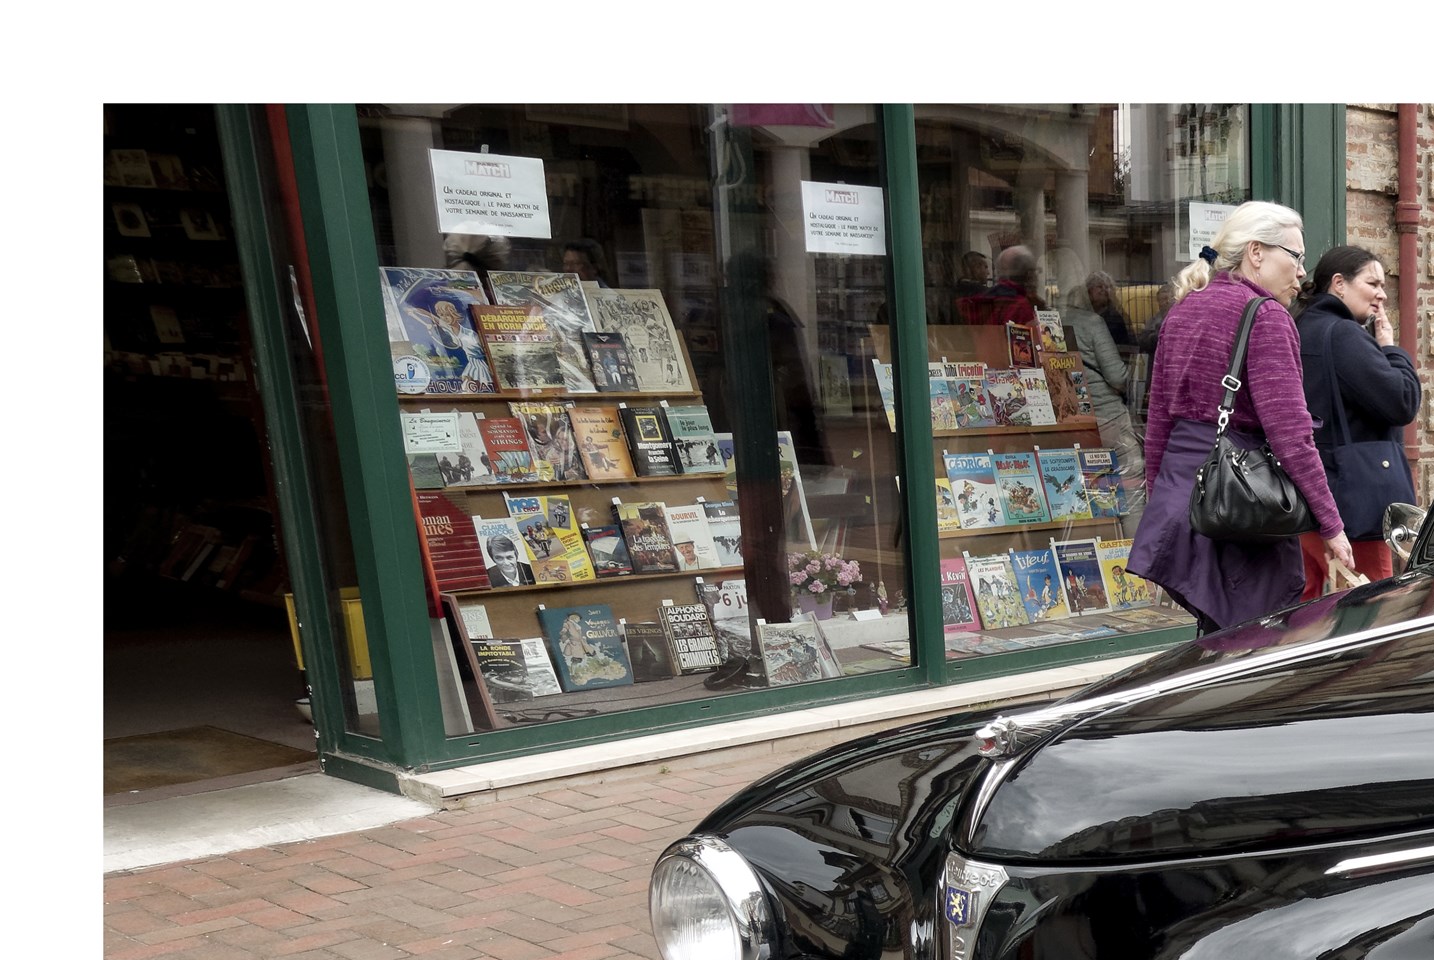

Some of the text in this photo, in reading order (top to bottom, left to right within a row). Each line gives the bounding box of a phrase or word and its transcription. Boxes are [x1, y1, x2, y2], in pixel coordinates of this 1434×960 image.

[465, 161, 510, 178] MATCH
[455, 188, 478, 196] CADEAU
[479, 190, 503, 199] ORIGINAL
[825, 190, 859, 204] MATCH
[444, 198, 481, 207] NOSTALGIQUE
[445, 207, 463, 215] VOTRE
[465, 209, 489, 217] SEMAINE
[480, 314, 546, 324] DÉBARQUEMENT
[484, 322, 549, 332] EN NORMANDIE
[944, 364, 958, 378] bibi
[957, 364, 984, 377] fricotin
[698, 424, 710, 432] long
[637, 441, 673, 450] Montgomery
[654, 455, 670, 463] Seine
[670, 511, 698, 521] BOURVIL
[481, 523, 508, 531] CLAUDE
[632, 534, 642, 543] La
[644, 542, 671, 552] Templiers
[1014, 550, 1050, 570] titeuf
[722, 592, 748, 609] 6 ju
[667, 605, 706, 615] ALPHONSE
[668, 612, 707, 623] BOUDARD
[675, 636, 716, 653] LES GRANDS
[679, 649, 721, 668] CRIMINELS
